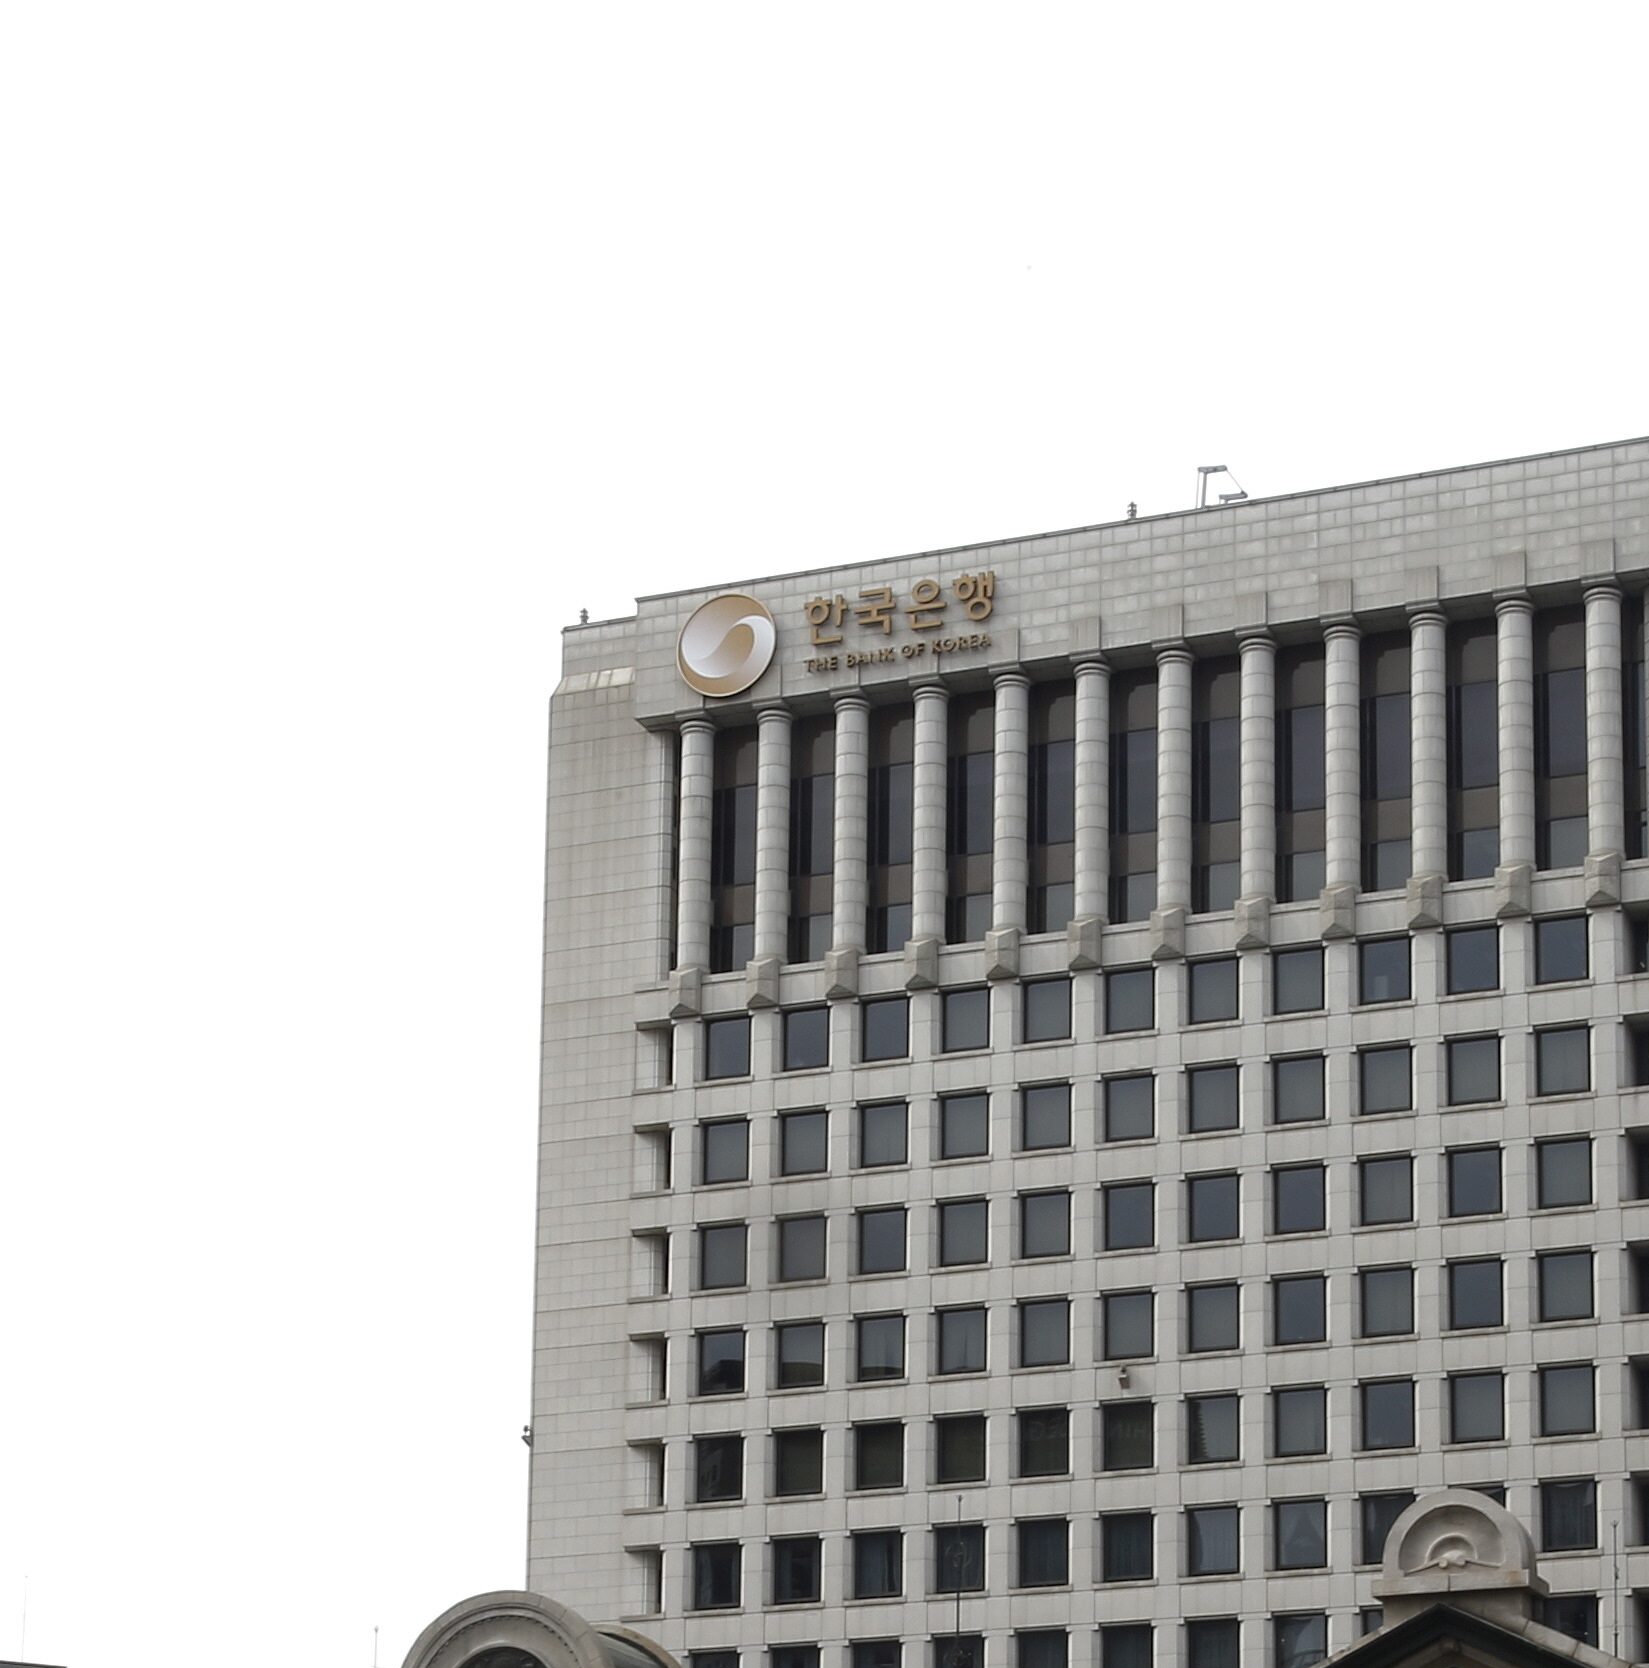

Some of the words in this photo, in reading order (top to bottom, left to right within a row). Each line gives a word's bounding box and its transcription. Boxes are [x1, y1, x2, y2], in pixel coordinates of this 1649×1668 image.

[805, 571, 995, 645] 한국은행
[803, 655, 839, 673] THE
[846, 647, 895, 668] BANK
[902, 642, 926, 659] OF
[931, 632, 992, 654] KOREA
